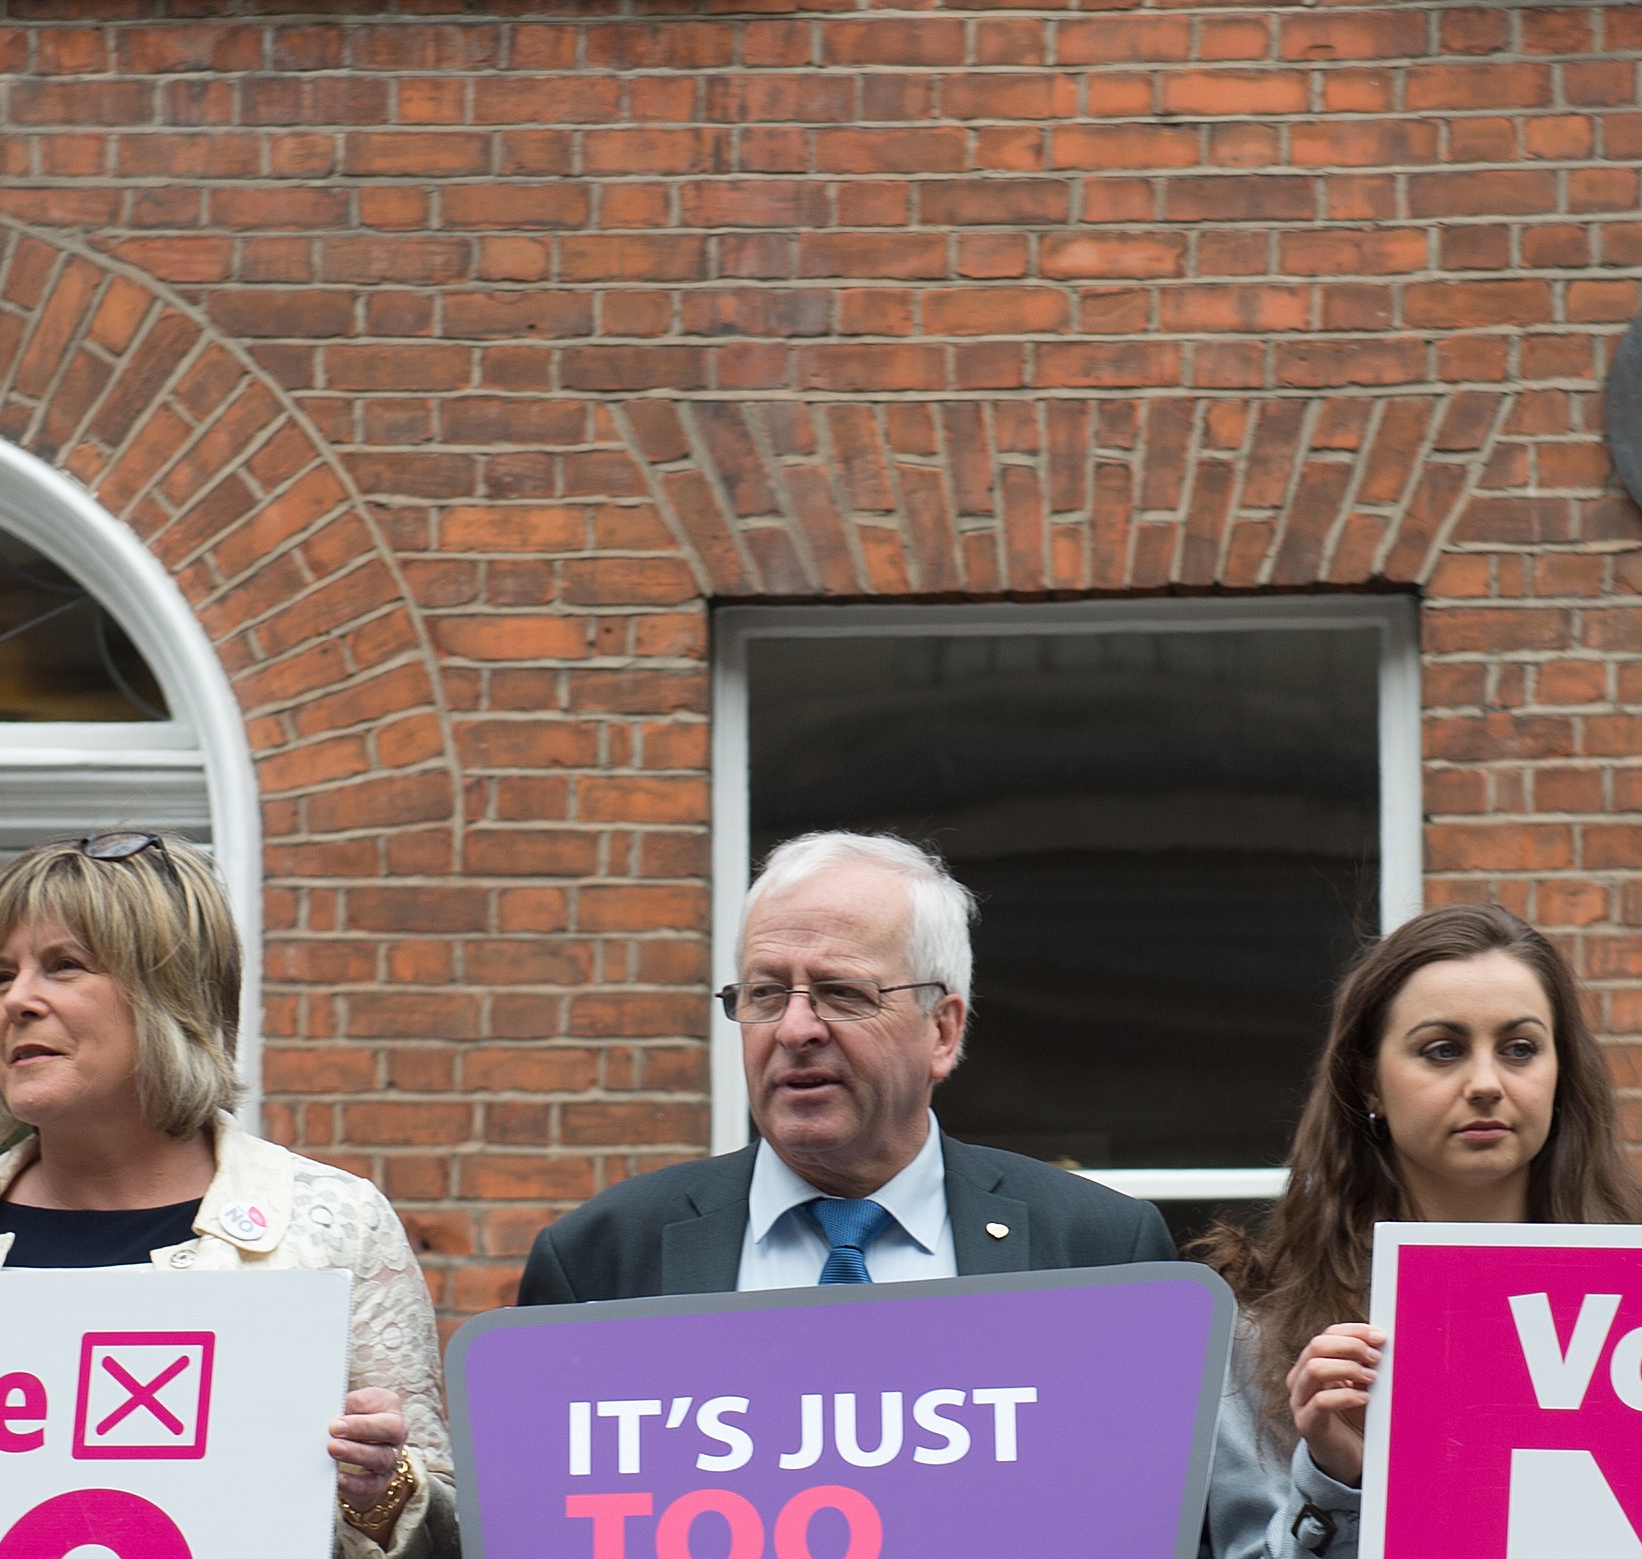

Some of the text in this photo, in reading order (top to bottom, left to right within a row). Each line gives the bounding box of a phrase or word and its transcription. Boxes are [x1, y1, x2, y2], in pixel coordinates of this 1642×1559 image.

[224, 1207, 254, 1233] NO
[569, 1386, 1037, 1476] IT'S JUST
